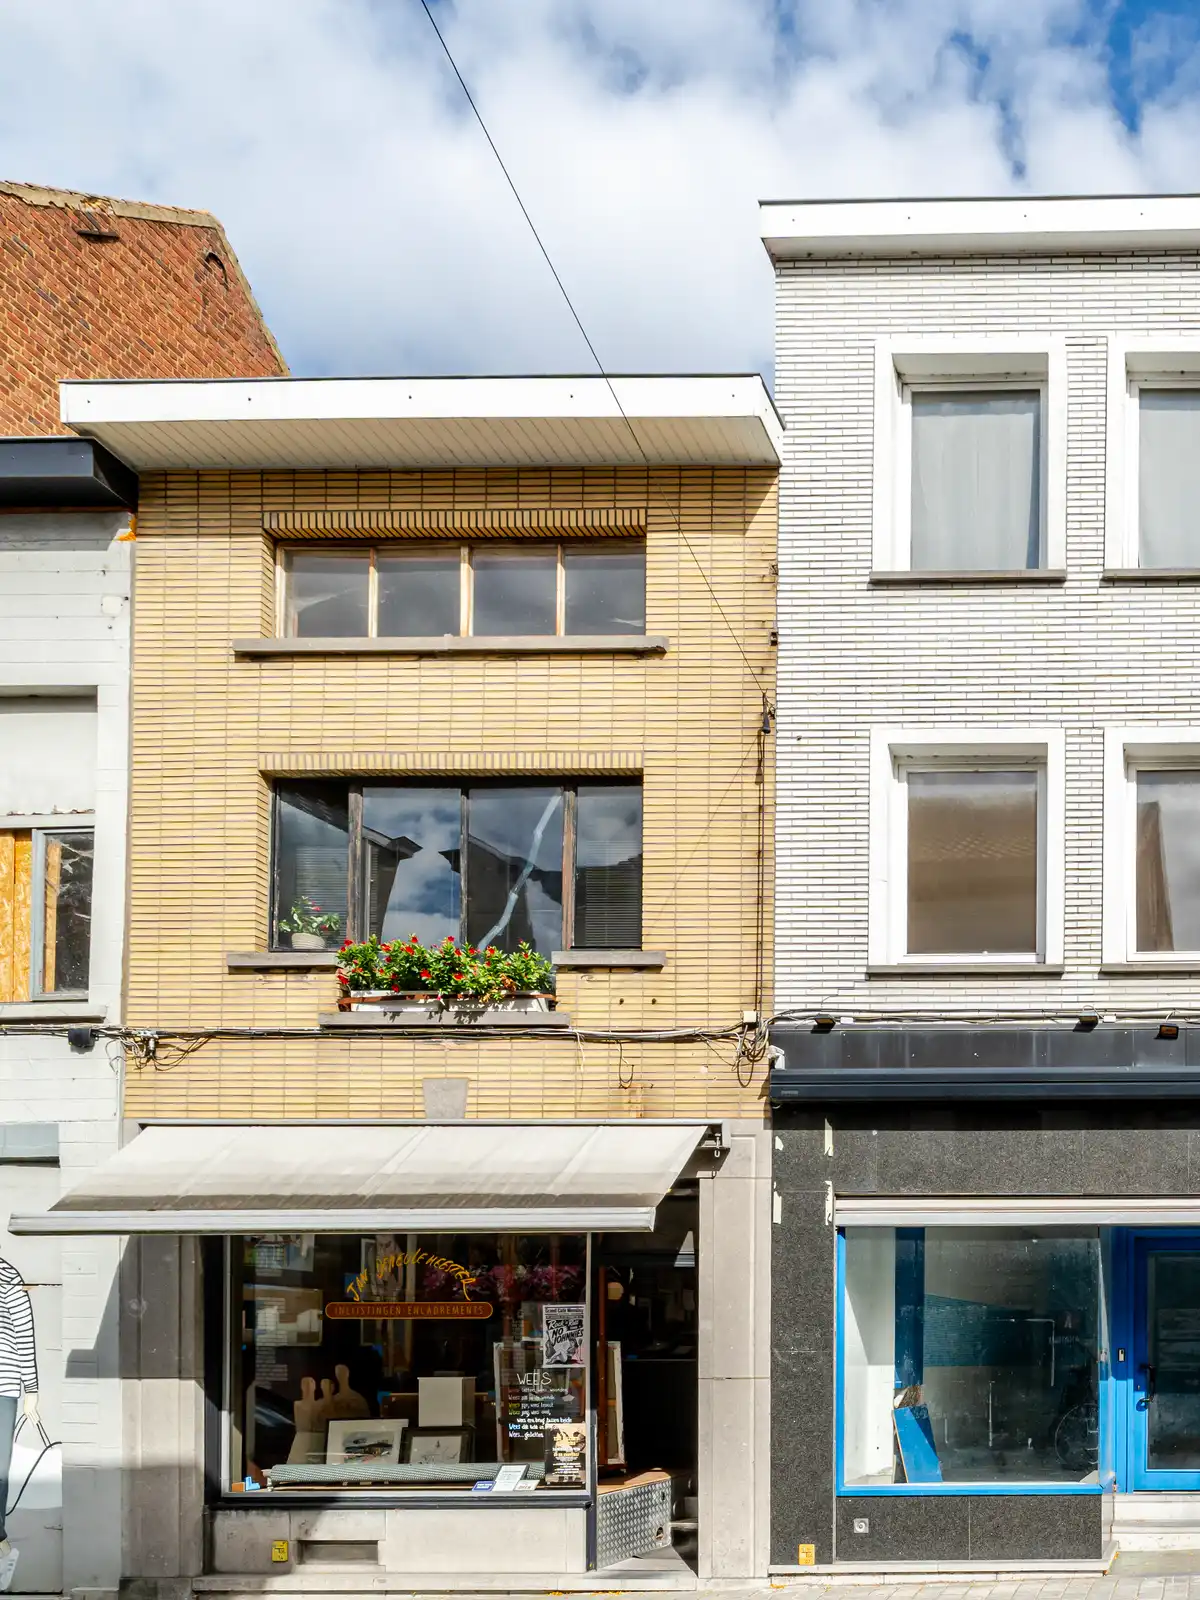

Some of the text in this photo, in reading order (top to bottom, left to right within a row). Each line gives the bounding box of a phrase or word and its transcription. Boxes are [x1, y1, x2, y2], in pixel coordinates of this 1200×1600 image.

[346, 1268, 369, 1302] JAN
[551, 1327, 564, 1339] NO
[516, 1371, 552, 1386] WEES
